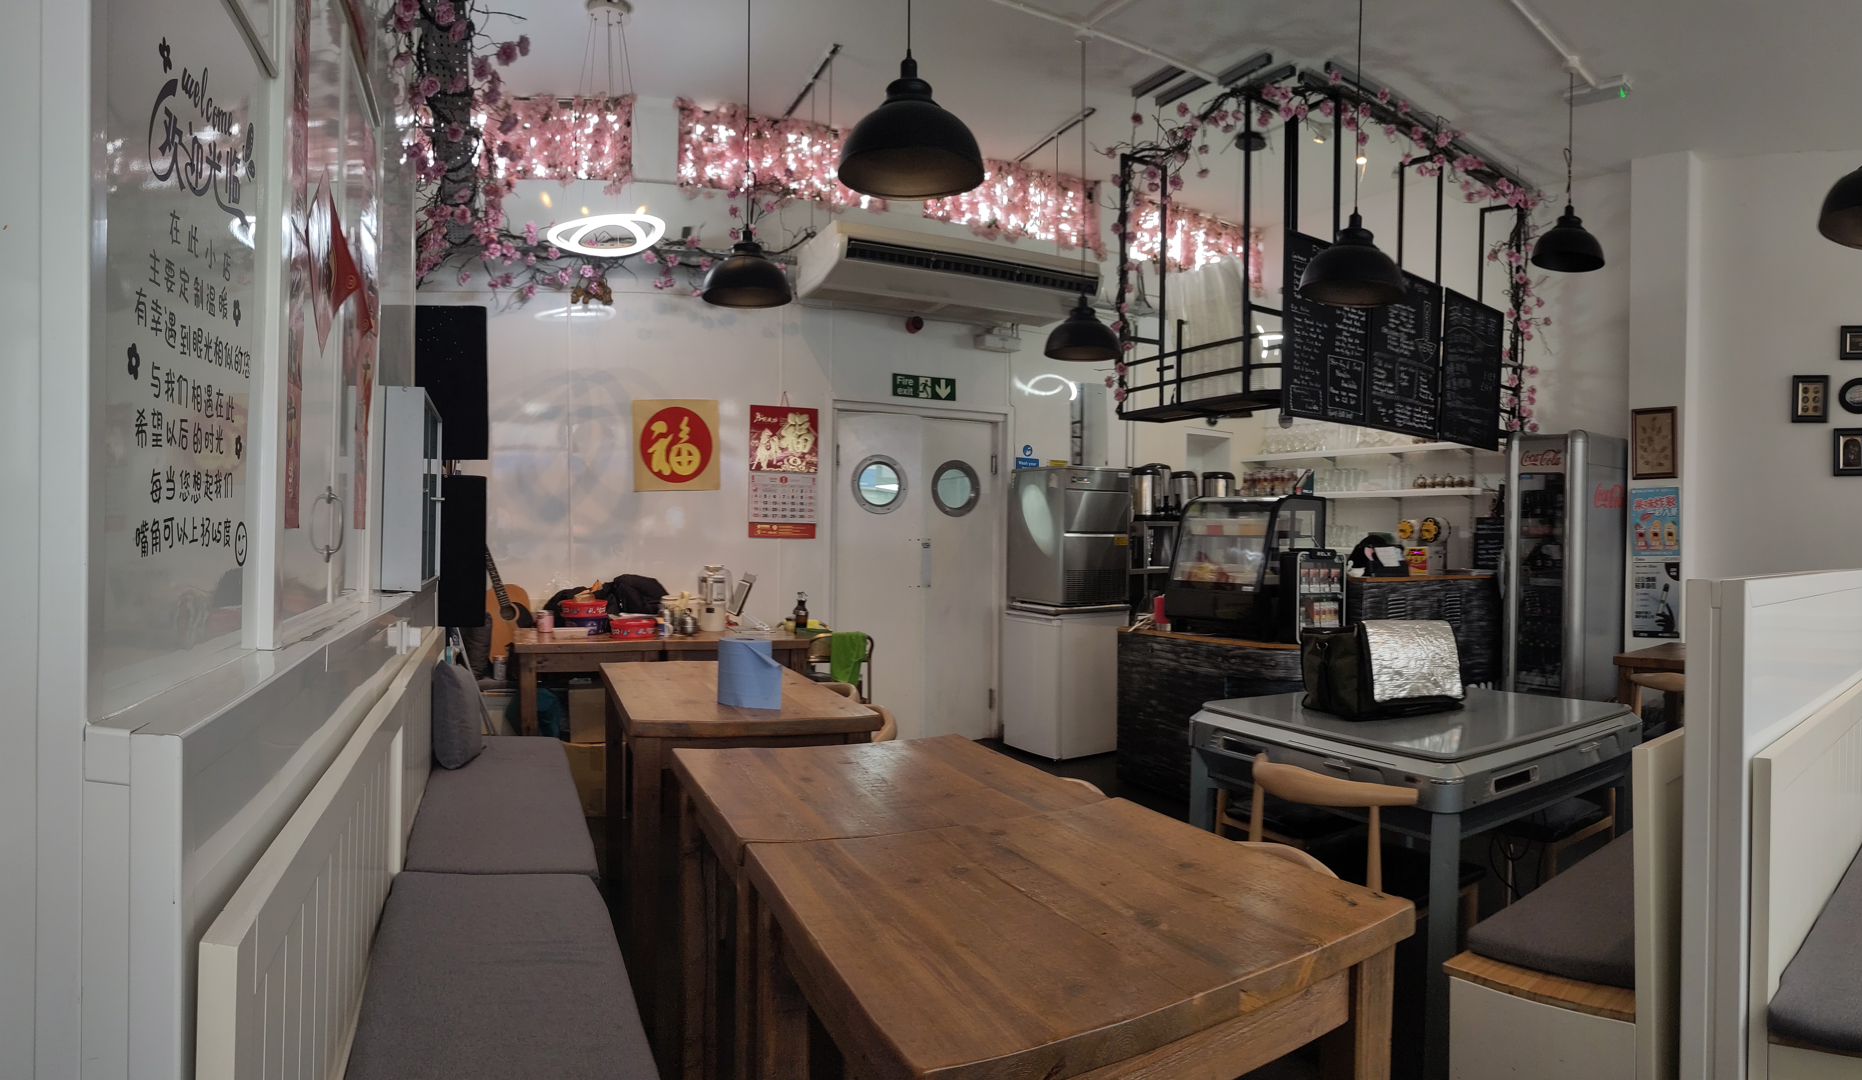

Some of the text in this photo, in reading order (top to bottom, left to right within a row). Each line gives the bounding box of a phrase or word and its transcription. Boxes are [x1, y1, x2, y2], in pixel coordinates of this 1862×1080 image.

[181, 67, 233, 136] welcome
[149, 79, 243, 210] 欢迎光临
[169, 209, 232, 282] 在此小店
[150, 361, 235, 424] 与我们相遇在此
[896, 375, 915, 387] Fire
[896, 387, 914, 396] exit
[135, 408, 224, 455] 希望以后的时光
[648, 415, 701, 477] 福
[1520, 449, 1562, 467] Coca-Cola
[150, 466, 233, 504] 每当您想起我们
